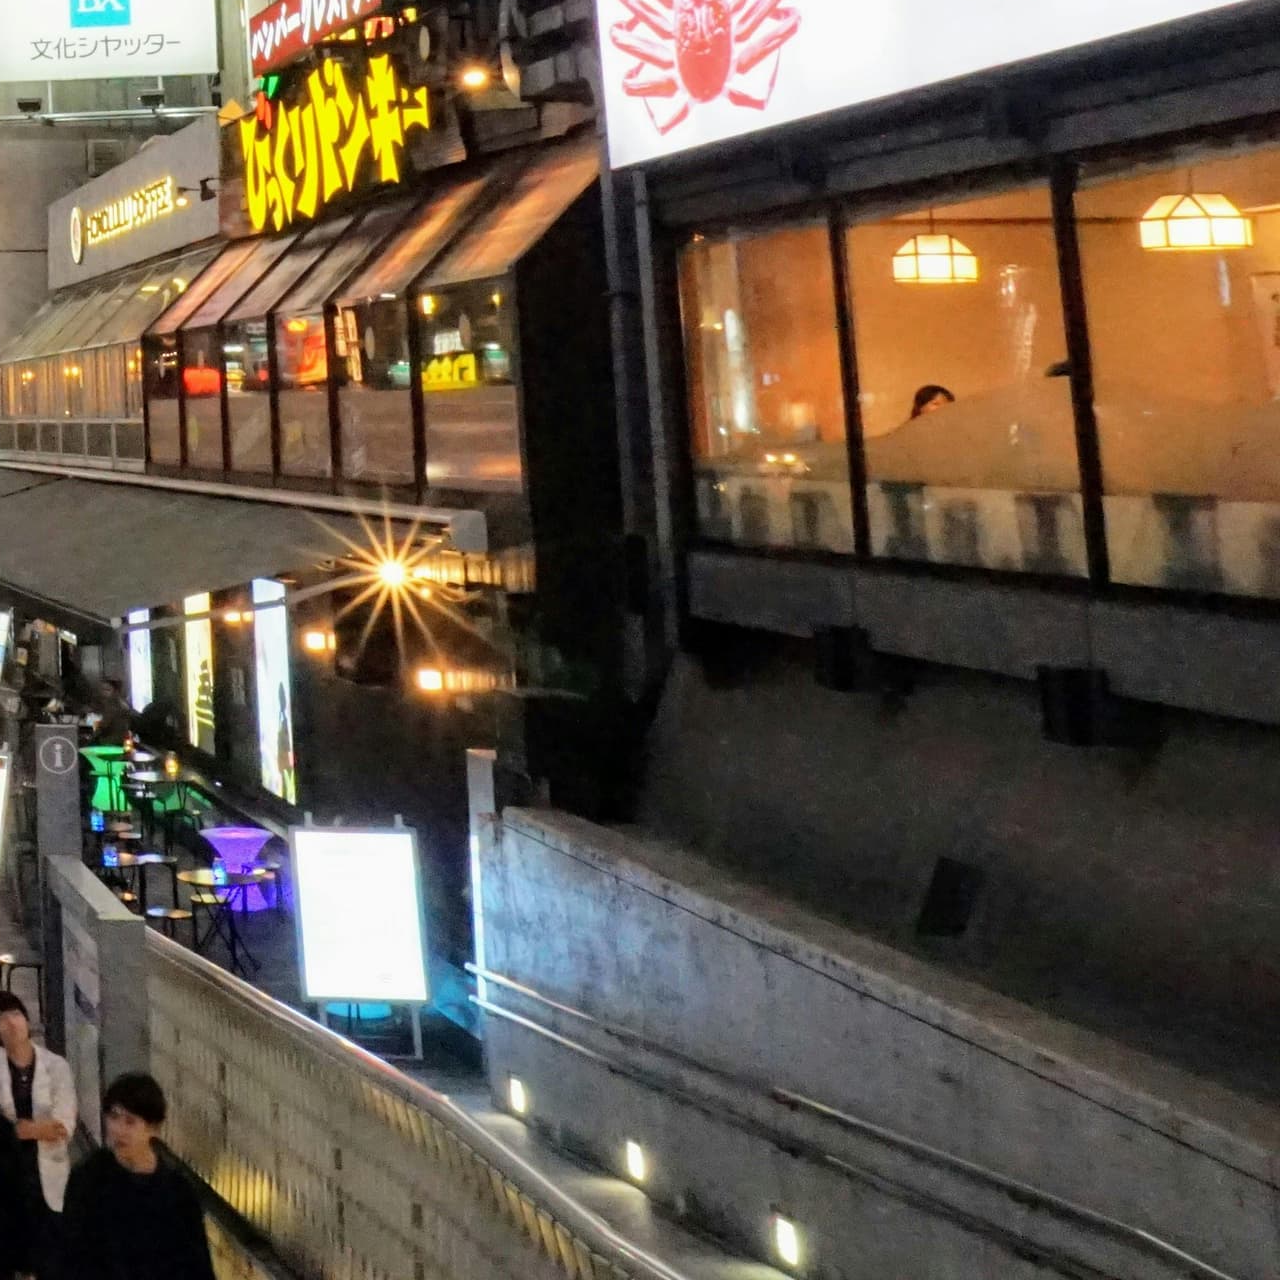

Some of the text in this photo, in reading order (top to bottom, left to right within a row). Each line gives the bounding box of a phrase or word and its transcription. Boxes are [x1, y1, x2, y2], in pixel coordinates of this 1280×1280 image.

[240, 54, 430, 232] びっくりドンキー
